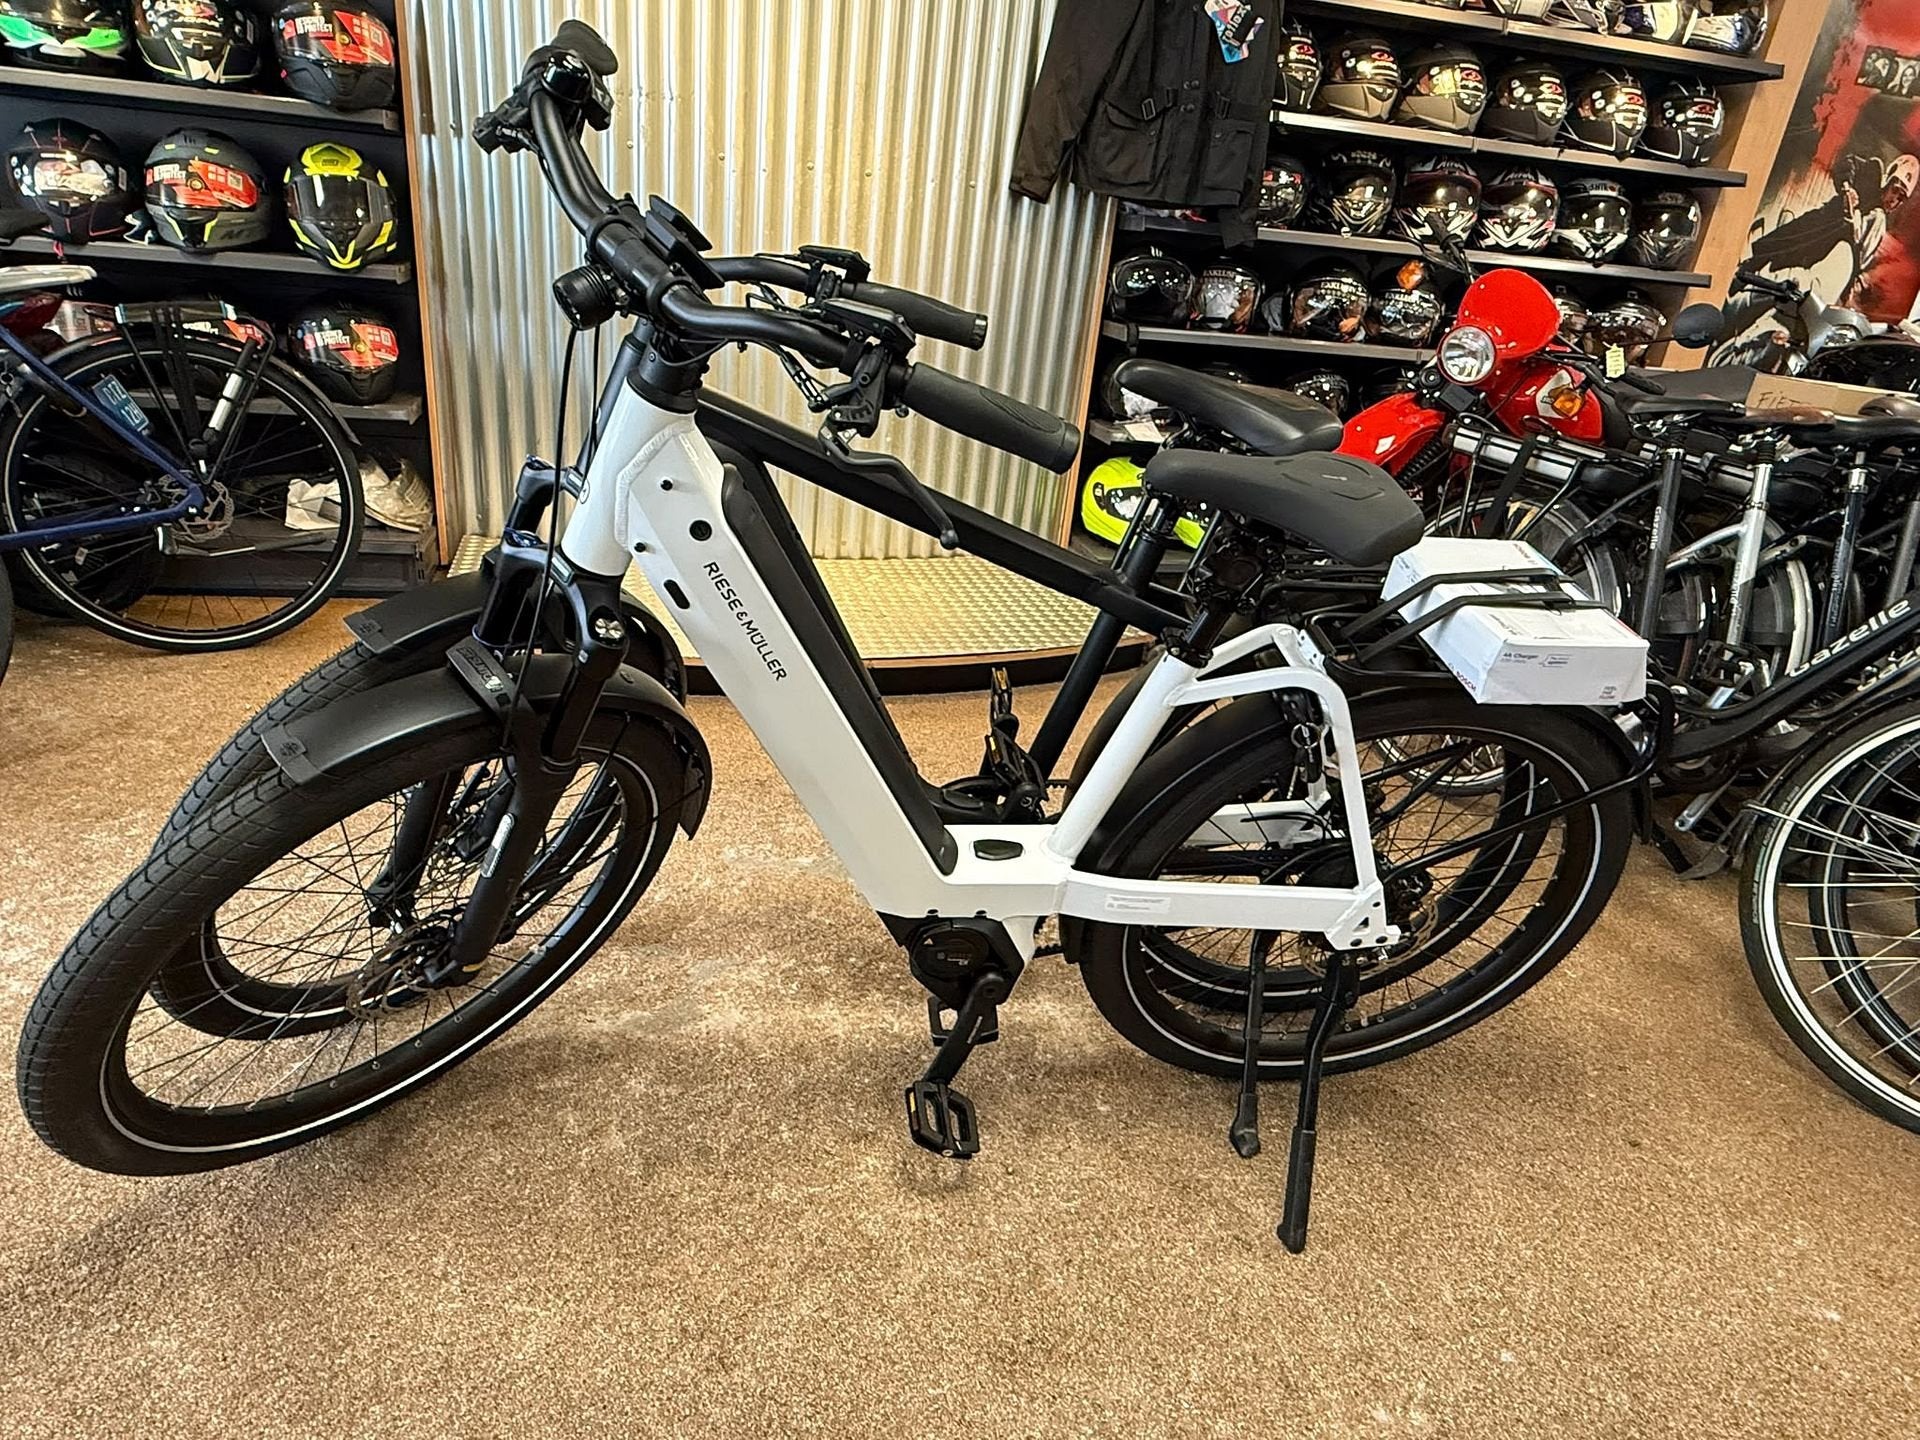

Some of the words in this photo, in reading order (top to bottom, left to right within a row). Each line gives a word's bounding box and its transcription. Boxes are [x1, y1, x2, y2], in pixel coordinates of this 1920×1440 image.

[703, 561, 744, 611] RIESE
[740, 619, 788, 682] MÜLLER
[1789, 599, 1912, 678] Gazelle
